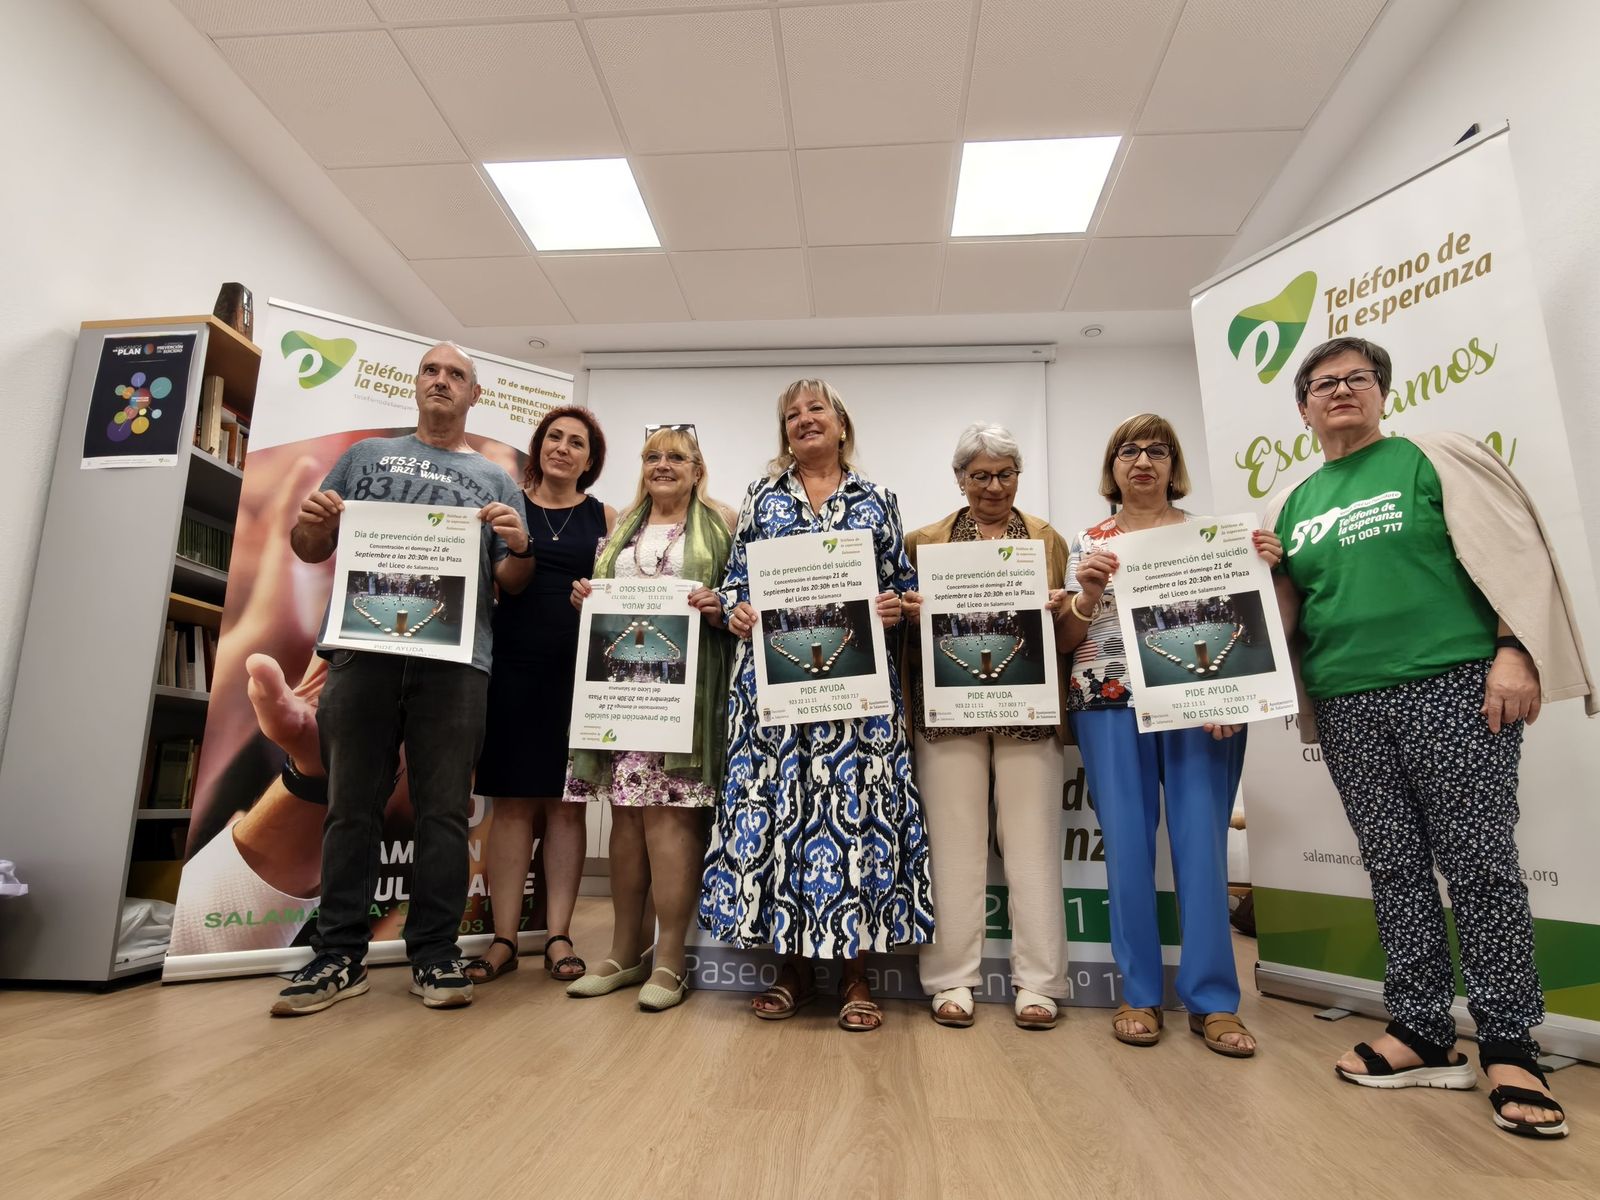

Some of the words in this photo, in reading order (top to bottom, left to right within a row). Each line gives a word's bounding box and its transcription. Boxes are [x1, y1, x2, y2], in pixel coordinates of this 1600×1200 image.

[1324, 252, 1430, 313] Teléfono
[1438, 232, 1471, 264] de
[1328, 313, 1348, 339] la
[1354, 252, 1492, 324] esperanza
[117, 348, 141, 356] PLAN
[354, 373, 371, 389] la
[373, 382, 416, 399] esper
[497, 377, 506, 386] 10
[520, 385, 566, 400] septiembre
[478, 397, 496, 407] ARA
[498, 402, 509, 410] LA
[511, 404, 545, 418] PREVEN
[498, 392, 561, 411] INTERNACION
[510, 414, 525, 423] DEL
[379, 456, 431, 470] 875.2-8
[390, 465, 415, 476] BRZL
[420, 470, 452, 483] WAVES
[1339, 507, 1379, 527] Teléfono
[1381, 502, 1396, 512] de
[1338, 525, 1347, 536] la
[1348, 511, 1403, 532] esperanza
[369, 531, 378, 539] de
[380, 532, 422, 541] prevención
[437, 536, 465, 544] suicidio
[1339, 534, 1356, 547] 717
[1358, 526, 1380, 540] 003
[1383, 522, 1403, 533] 717
[354, 551, 391, 559] Septiembre
[1127, 564, 1140, 573] Día
[1142, 562, 1152, 570] de
[1154, 553, 1199, 570] prevención
[1201, 552, 1214, 561] del
[1216, 547, 1248, 558] suicidio
[772, 568, 781, 576] de
[782, 563, 821, 575] prevención
[822, 562, 833, 571] del
[836, 559, 861, 570] suicidio
[955, 570, 996, 581] prevención
[997, 569, 1008, 577] del
[1010, 568, 1035, 576] suicidio
[1145, 570, 1182, 581] Concentración
[1189, 566, 1213, 574] domingo
[1132, 581, 1171, 593] Septiembre
[1188, 576, 1211, 585] 20:30h
[1232, 570, 1250, 578] Plaza
[763, 587, 795, 597] Septiembre
[811, 583, 831, 591] 20:30h
[934, 593, 967, 601] Septiembre
[1159, 591, 1169, 599] del
[1171, 589, 1189, 598] Liceo
[1198, 585, 1226, 594] Salamanca
[785, 596, 794, 604] del
[800, 686, 817, 695] PIDE
[820, 684, 845, 693] AYUDA
[986, 691, 1013, 699] AYUDA
[1185, 688, 1205, 698] PIDE
[1207, 684, 1239, 695] AYUDA
[798, 706, 809, 715] NO
[811, 703, 831, 713] ESTÁS
[833, 703, 852, 712] SOLO
[963, 711, 975, 719] NO
[976, 710, 998, 718] ESTÁS
[999, 710, 1019, 718] SOLO
[1183, 710, 1197, 720] NO
[1199, 707, 1224, 718] ESTÁS
[1226, 705, 1249, 715] SOLO
[622, 714, 658, 722] prevención
[1062, 767, 1095, 811] d
[1303, 850, 1362, 866] salamanca
[1521, 869, 1558, 886] a.org
[204, 903, 389, 928] SALAMAA:
[459, 920, 484, 933] 03
[685, 954, 777, 987] Paseo
[868, 968, 903, 991] an
[1103, 972, 1122, 1001] 1
